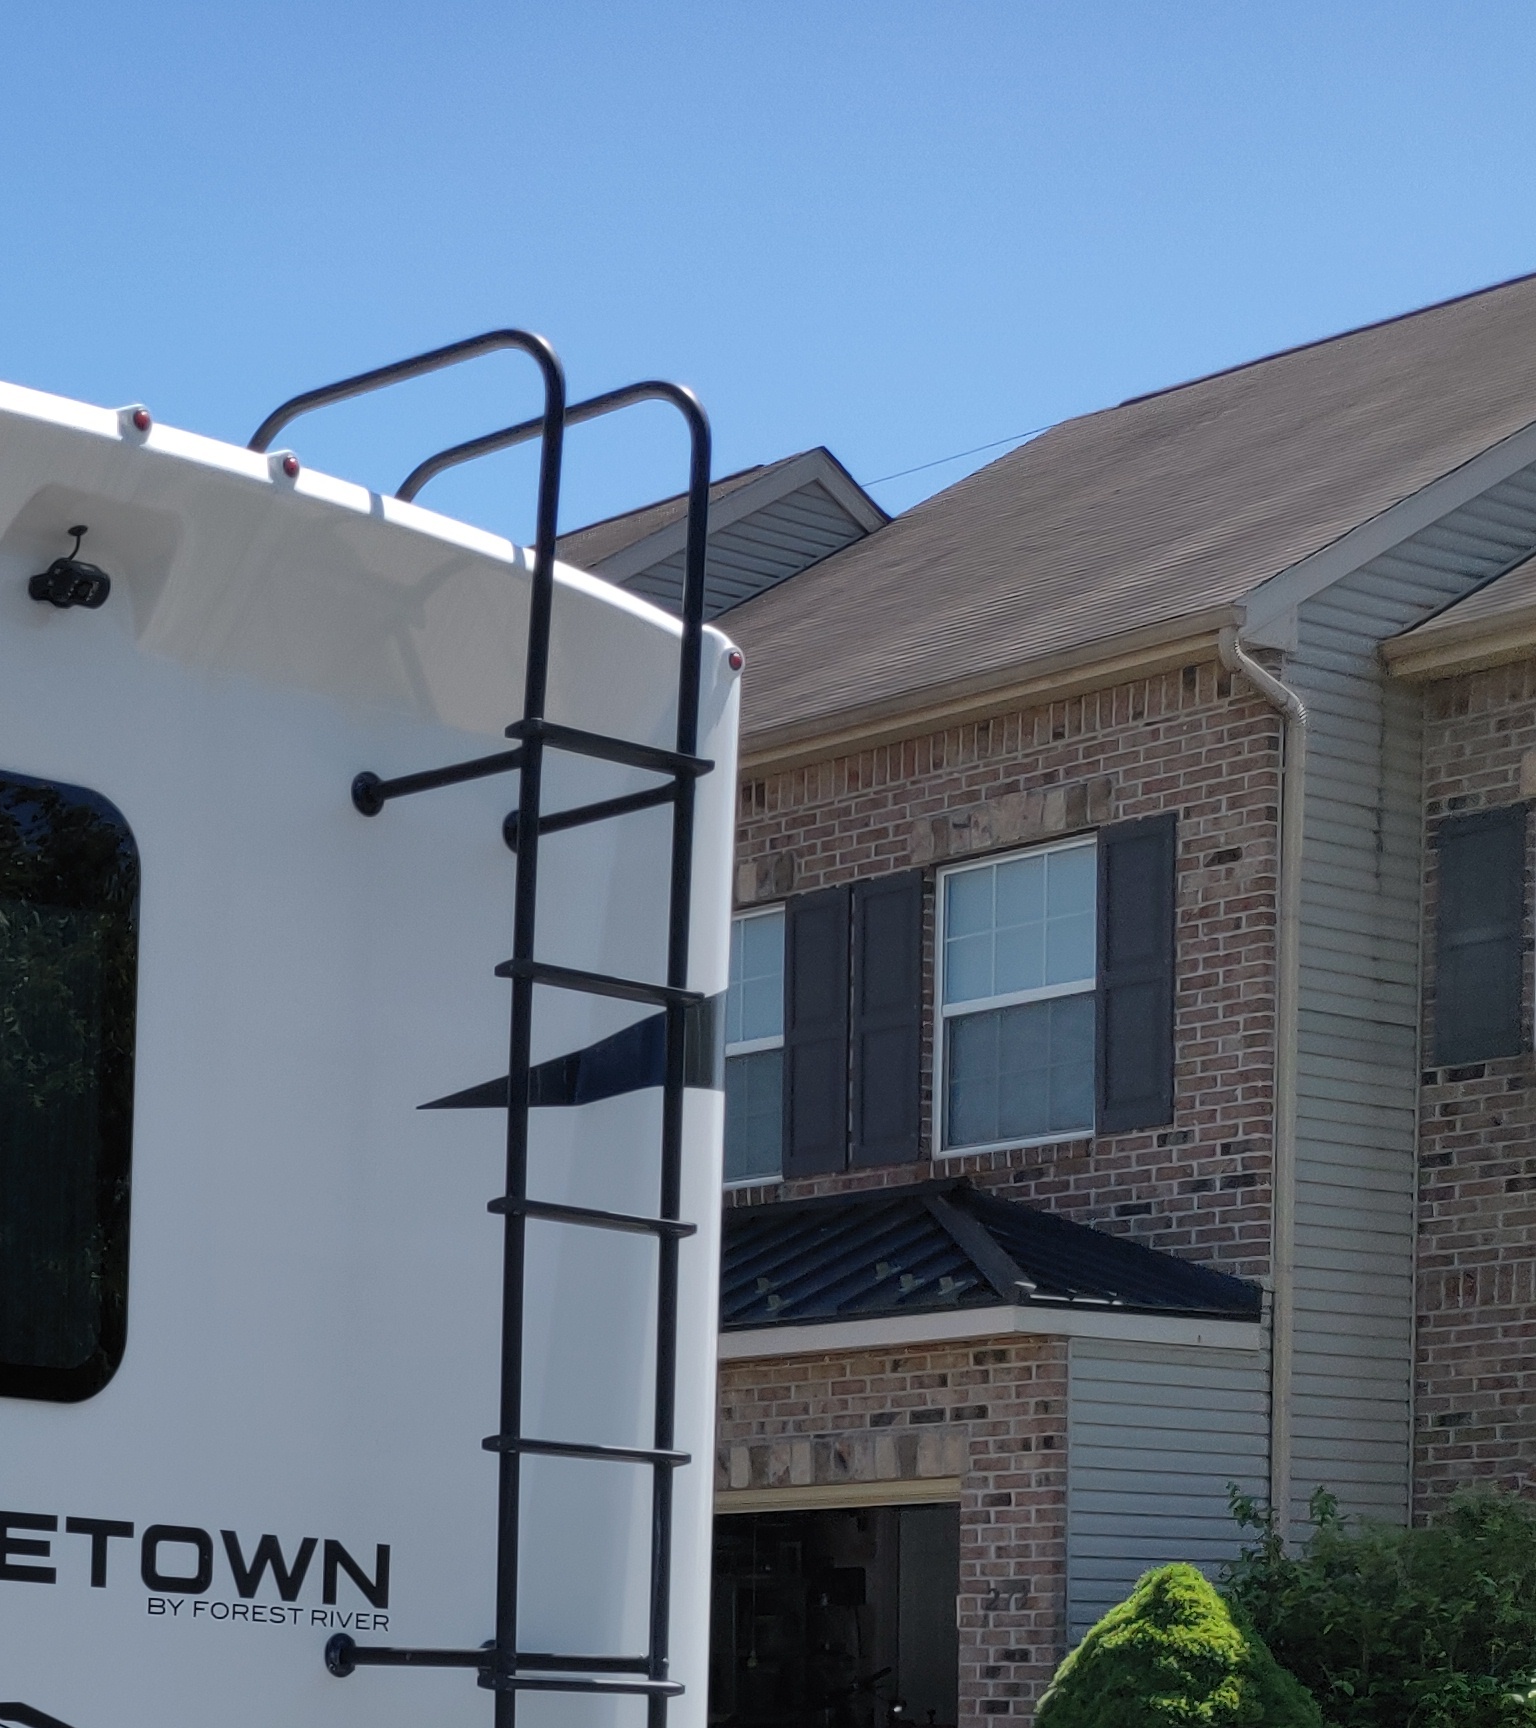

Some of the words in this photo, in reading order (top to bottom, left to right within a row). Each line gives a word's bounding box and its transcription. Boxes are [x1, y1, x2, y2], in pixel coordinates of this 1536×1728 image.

[147, 1597, 184, 1616] BY
[193, 1600, 304, 1625] FOREST
[311, 1609, 390, 1632] RIVER
